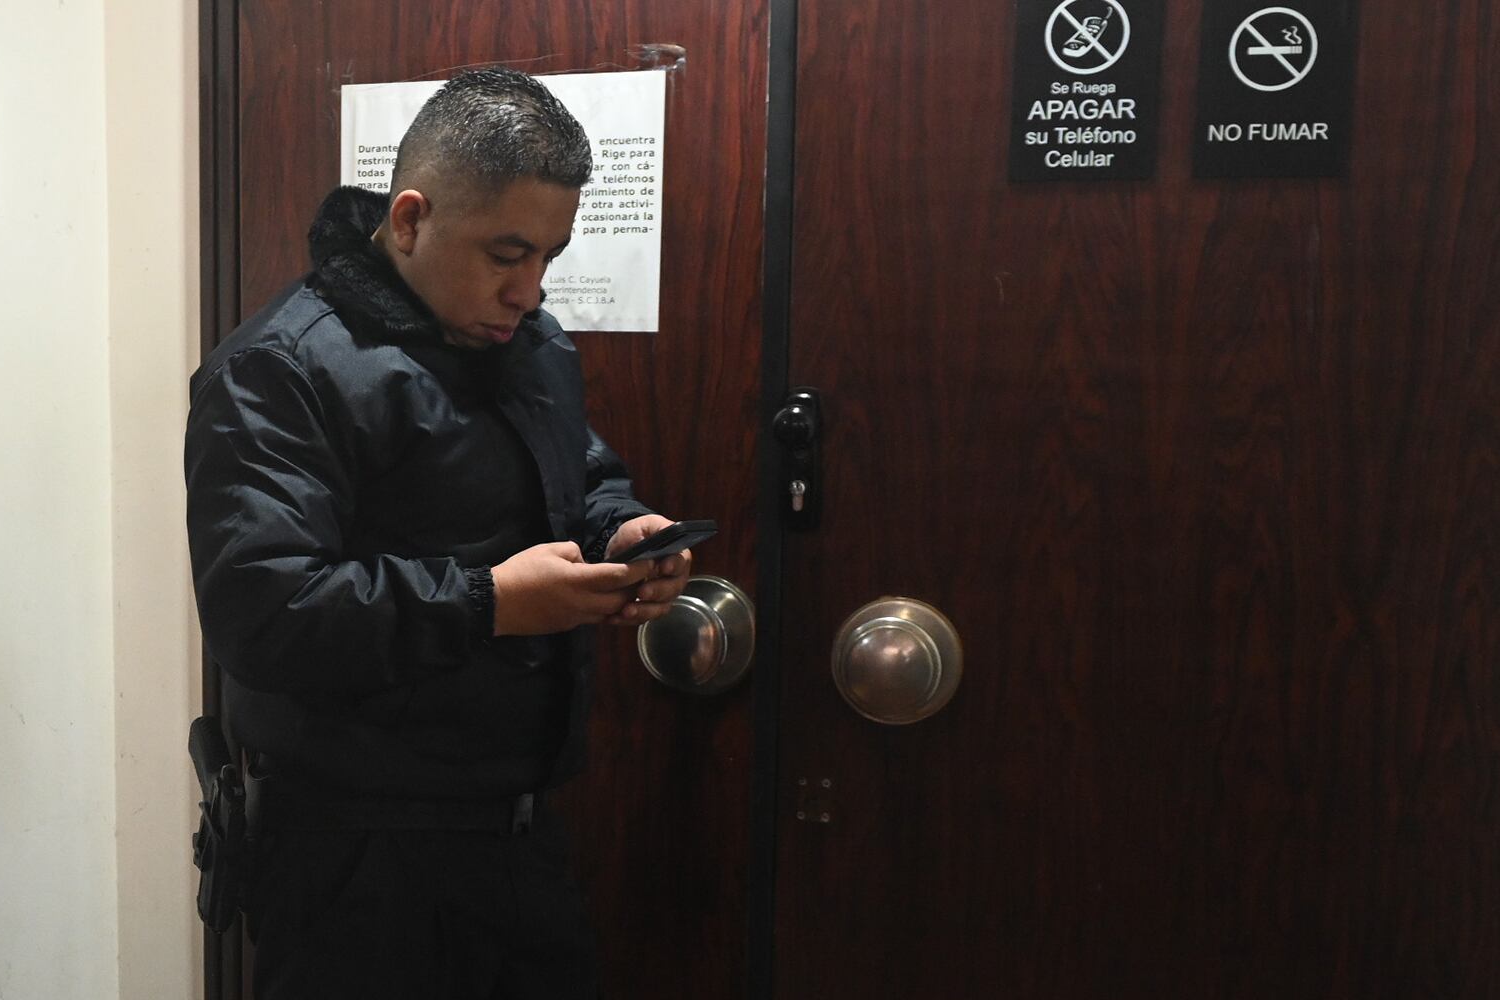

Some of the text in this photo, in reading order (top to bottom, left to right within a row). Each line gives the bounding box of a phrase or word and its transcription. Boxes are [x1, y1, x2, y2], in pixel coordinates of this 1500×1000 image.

[1051, 82, 1116, 95] Se Ruega
[1028, 99, 1136, 120] APAGAR
[1025, 128, 1136, 144] su Teléfono
[1208, 123, 1328, 141] NO FUMAR
[599, 137, 655, 145] encuentra
[602, 150, 655, 159] Rige para
[1045, 151, 1114, 168] Celular
[637, 161, 654, 170] cá-
[604, 175, 654, 183] teléfonos
[640, 187, 654, 195] de
[619, 200, 653, 208] activi-
[581, 212, 653, 221] ocasionará la
